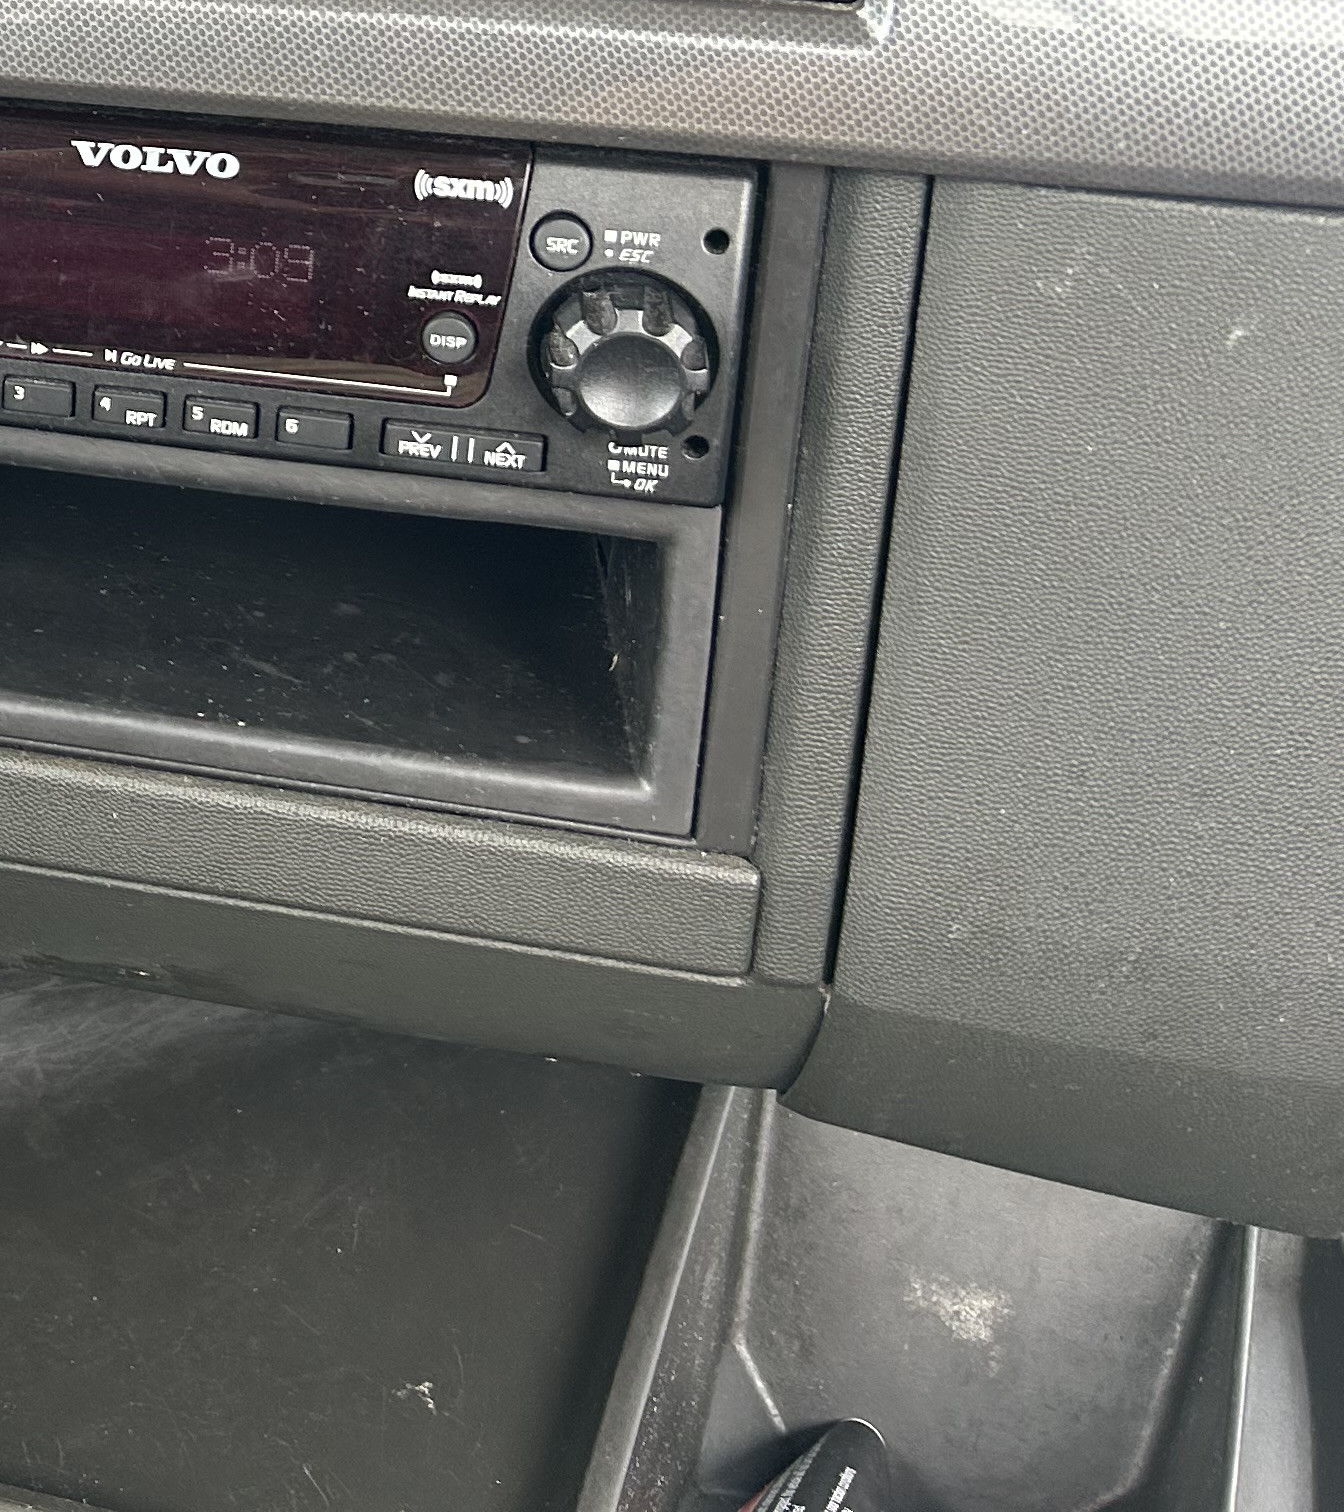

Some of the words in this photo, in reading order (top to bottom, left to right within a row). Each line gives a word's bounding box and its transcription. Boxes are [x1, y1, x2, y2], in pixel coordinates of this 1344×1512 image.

[71, 140, 240, 179] VOLVO
[546, 237, 580, 254] SRC
[620, 230, 661, 247] PWR
[618, 249, 654, 264] ESC
[429, 334, 467, 349] DISP
[14, 386, 25, 400] 3
[100, 397, 112, 412] 4
[125, 410, 158, 427] RPT
[192, 406, 204, 421] 5
[210, 419, 248, 437] RDM
[285, 419, 299, 433] 6
[398, 440, 442, 459] PREV
[623, 444, 668, 459] MUTE
[484, 450, 526, 470] NEXT
[622, 461, 669, 477] MENU
[633, 478, 658, 493] OK
